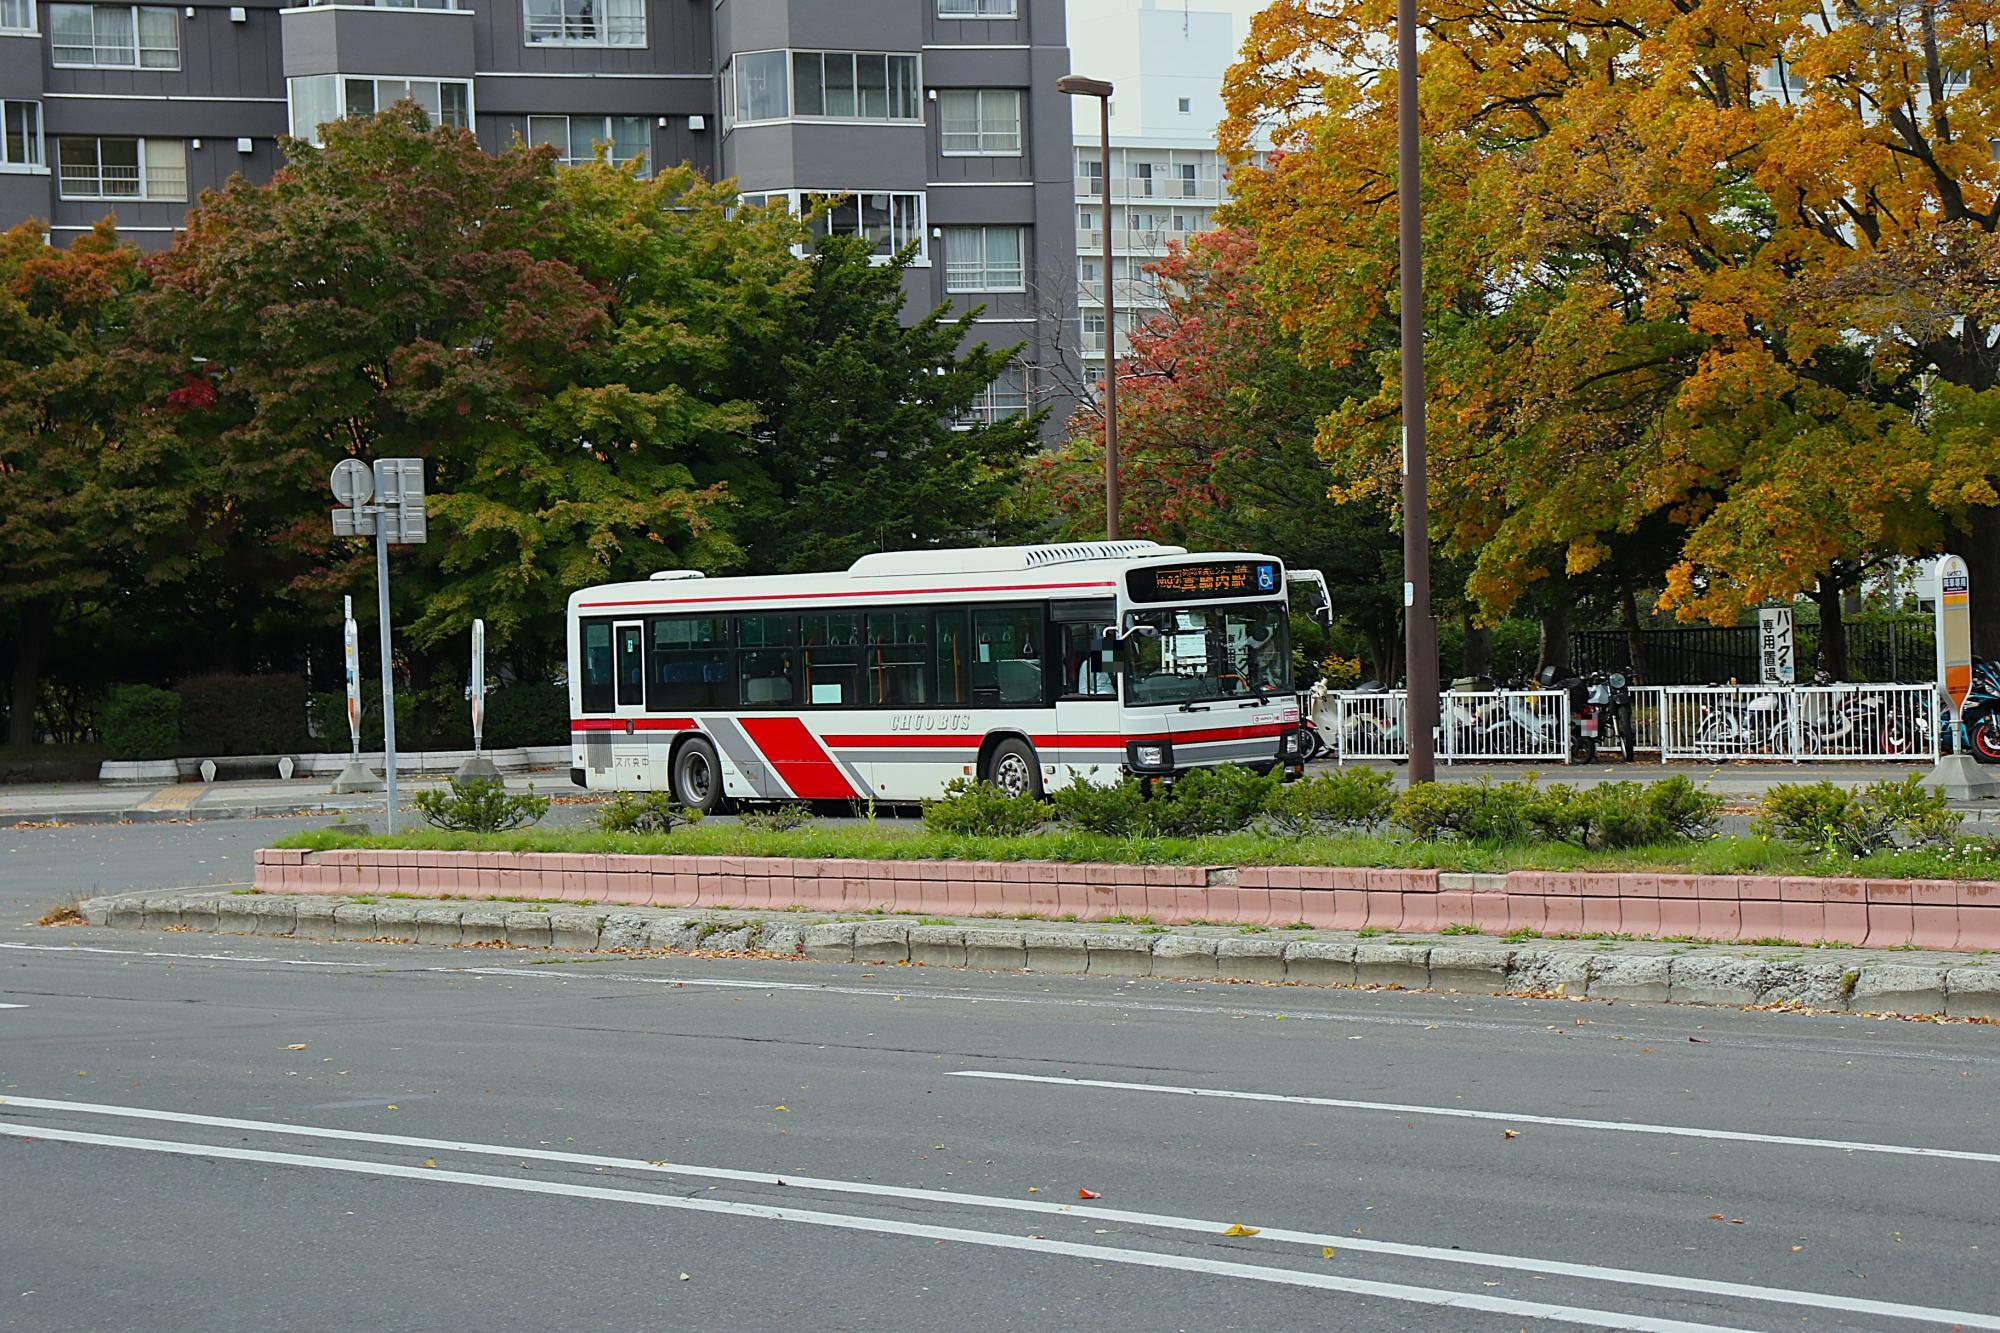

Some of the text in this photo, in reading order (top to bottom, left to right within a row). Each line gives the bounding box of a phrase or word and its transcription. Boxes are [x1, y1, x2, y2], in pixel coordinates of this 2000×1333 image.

[1762, 618, 1777, 681] 専用置場
[1777, 610, 1791, 661] バイク
[890, 713, 970, 731] CHUO BUS
